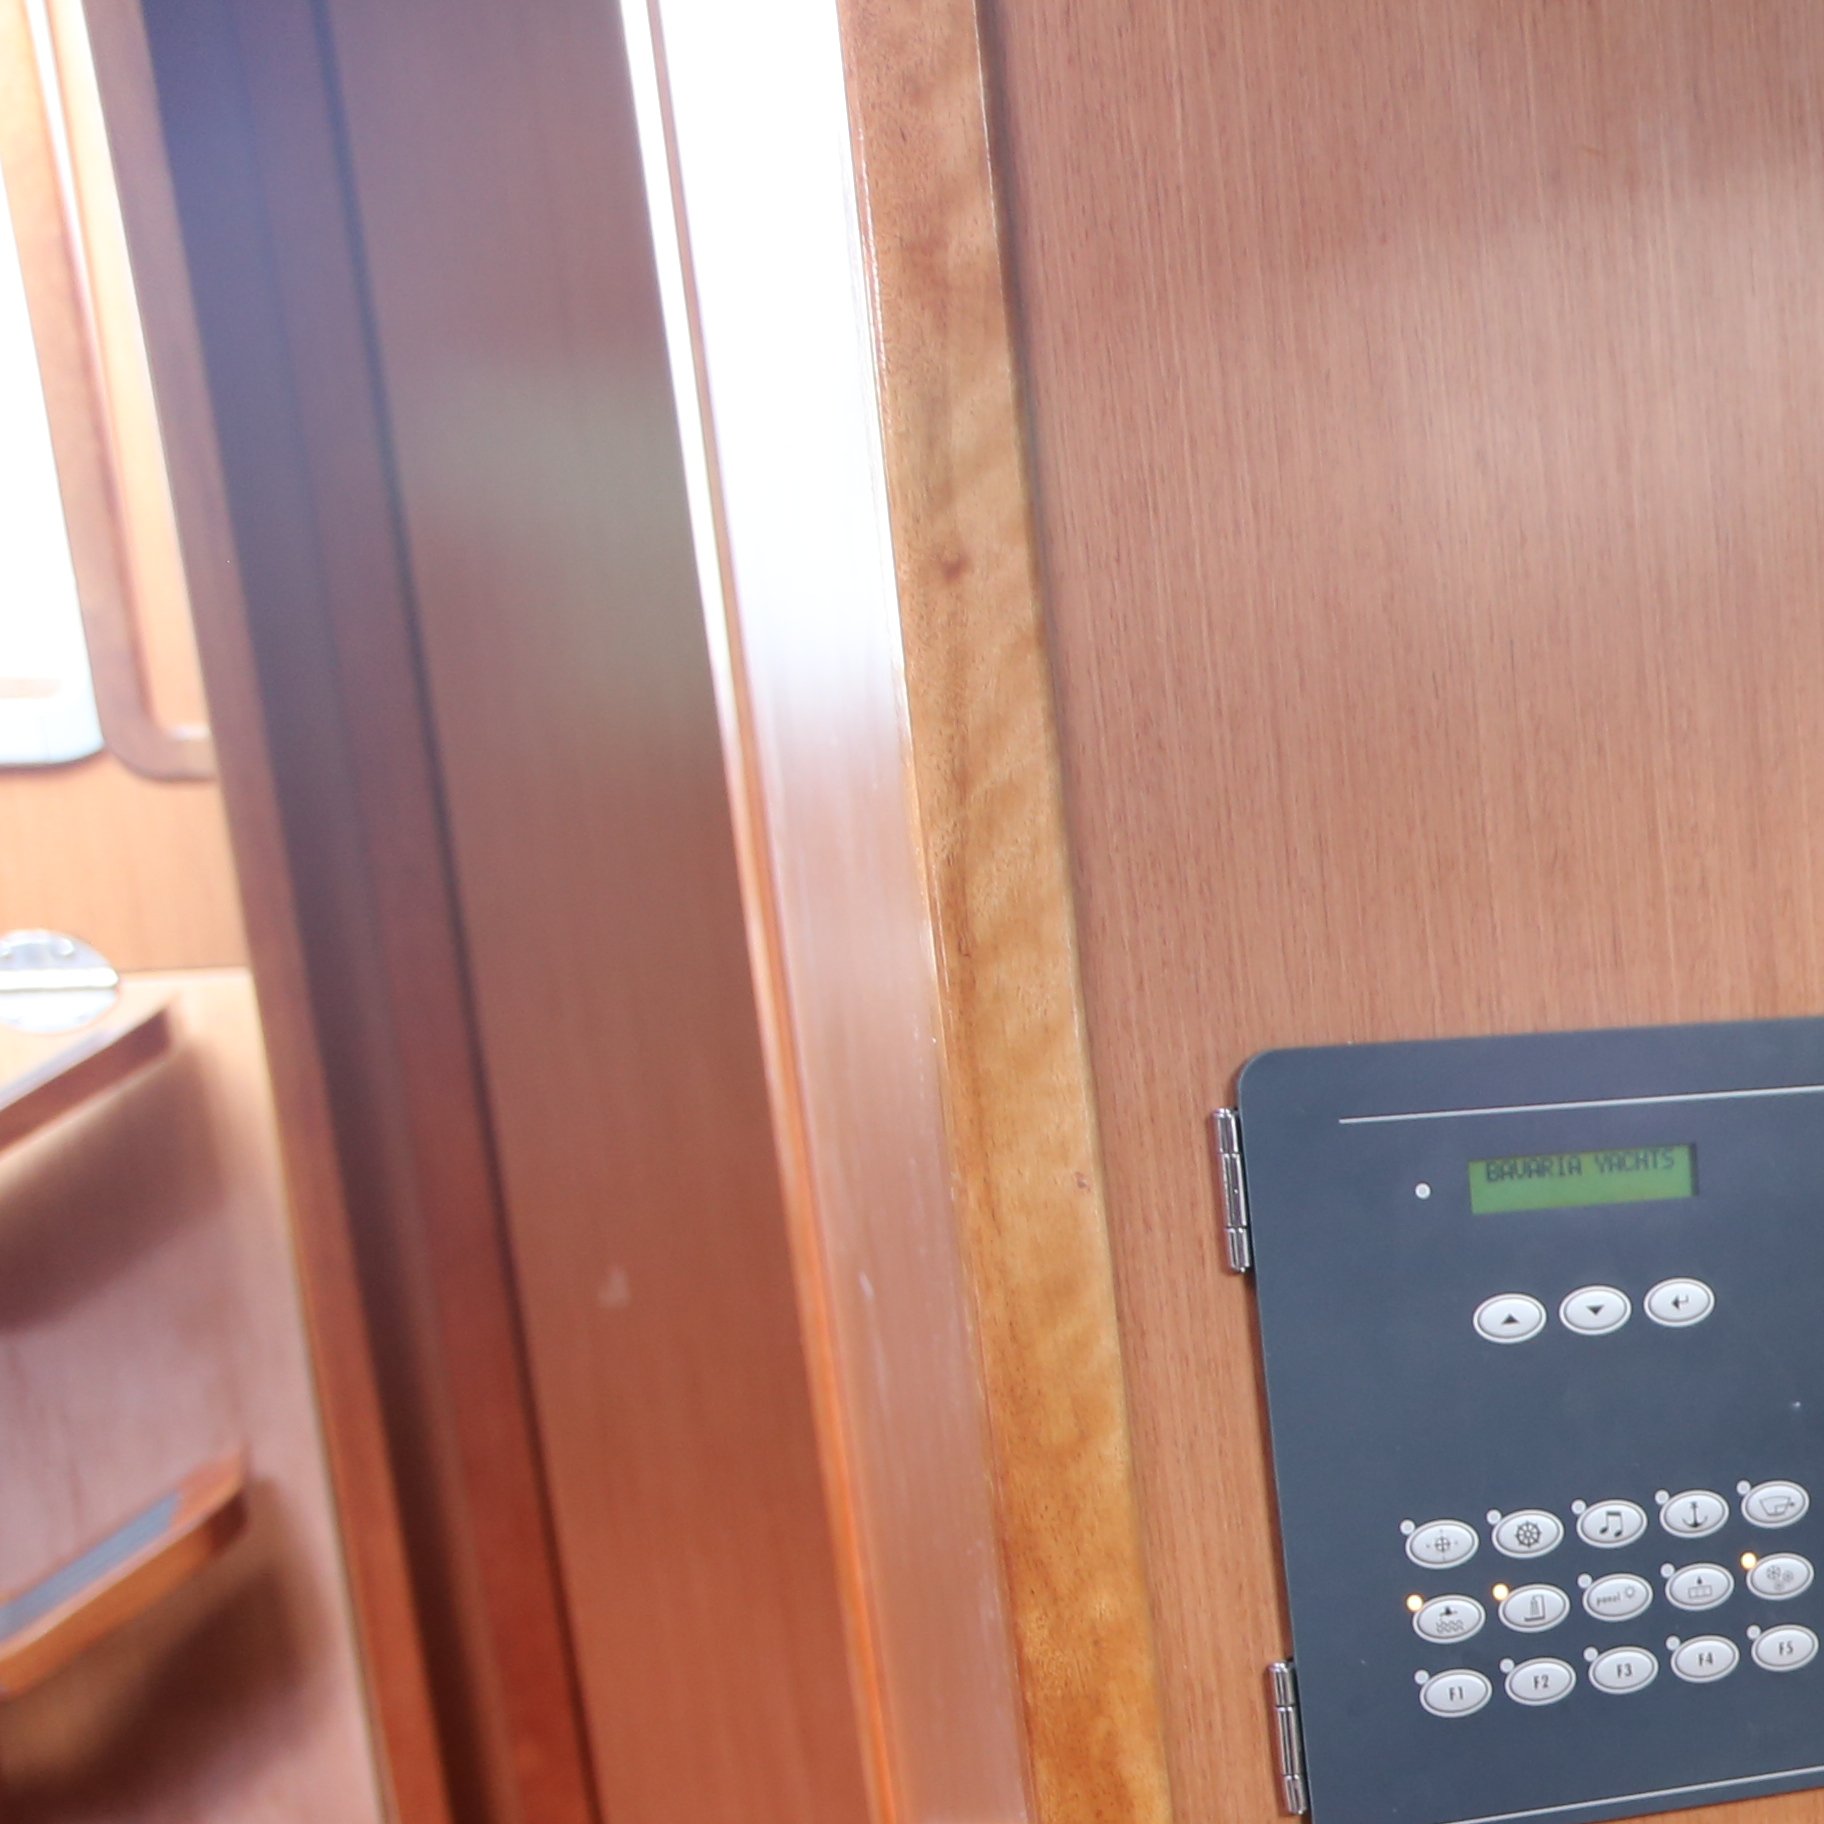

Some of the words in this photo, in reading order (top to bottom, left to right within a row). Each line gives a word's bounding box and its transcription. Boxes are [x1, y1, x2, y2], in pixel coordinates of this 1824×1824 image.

[1485, 1154, 1583, 1182] BAVARIA
[1593, 1148, 1676, 1174] YACHTS
[1778, 1641, 1795, 1657] F5
[1698, 1651, 1715, 1668] F4
[1616, 1662, 1633, 1679] F3
[1533, 1674, 1550, 1691] F2
[1449, 1686, 1464, 1702] F1
